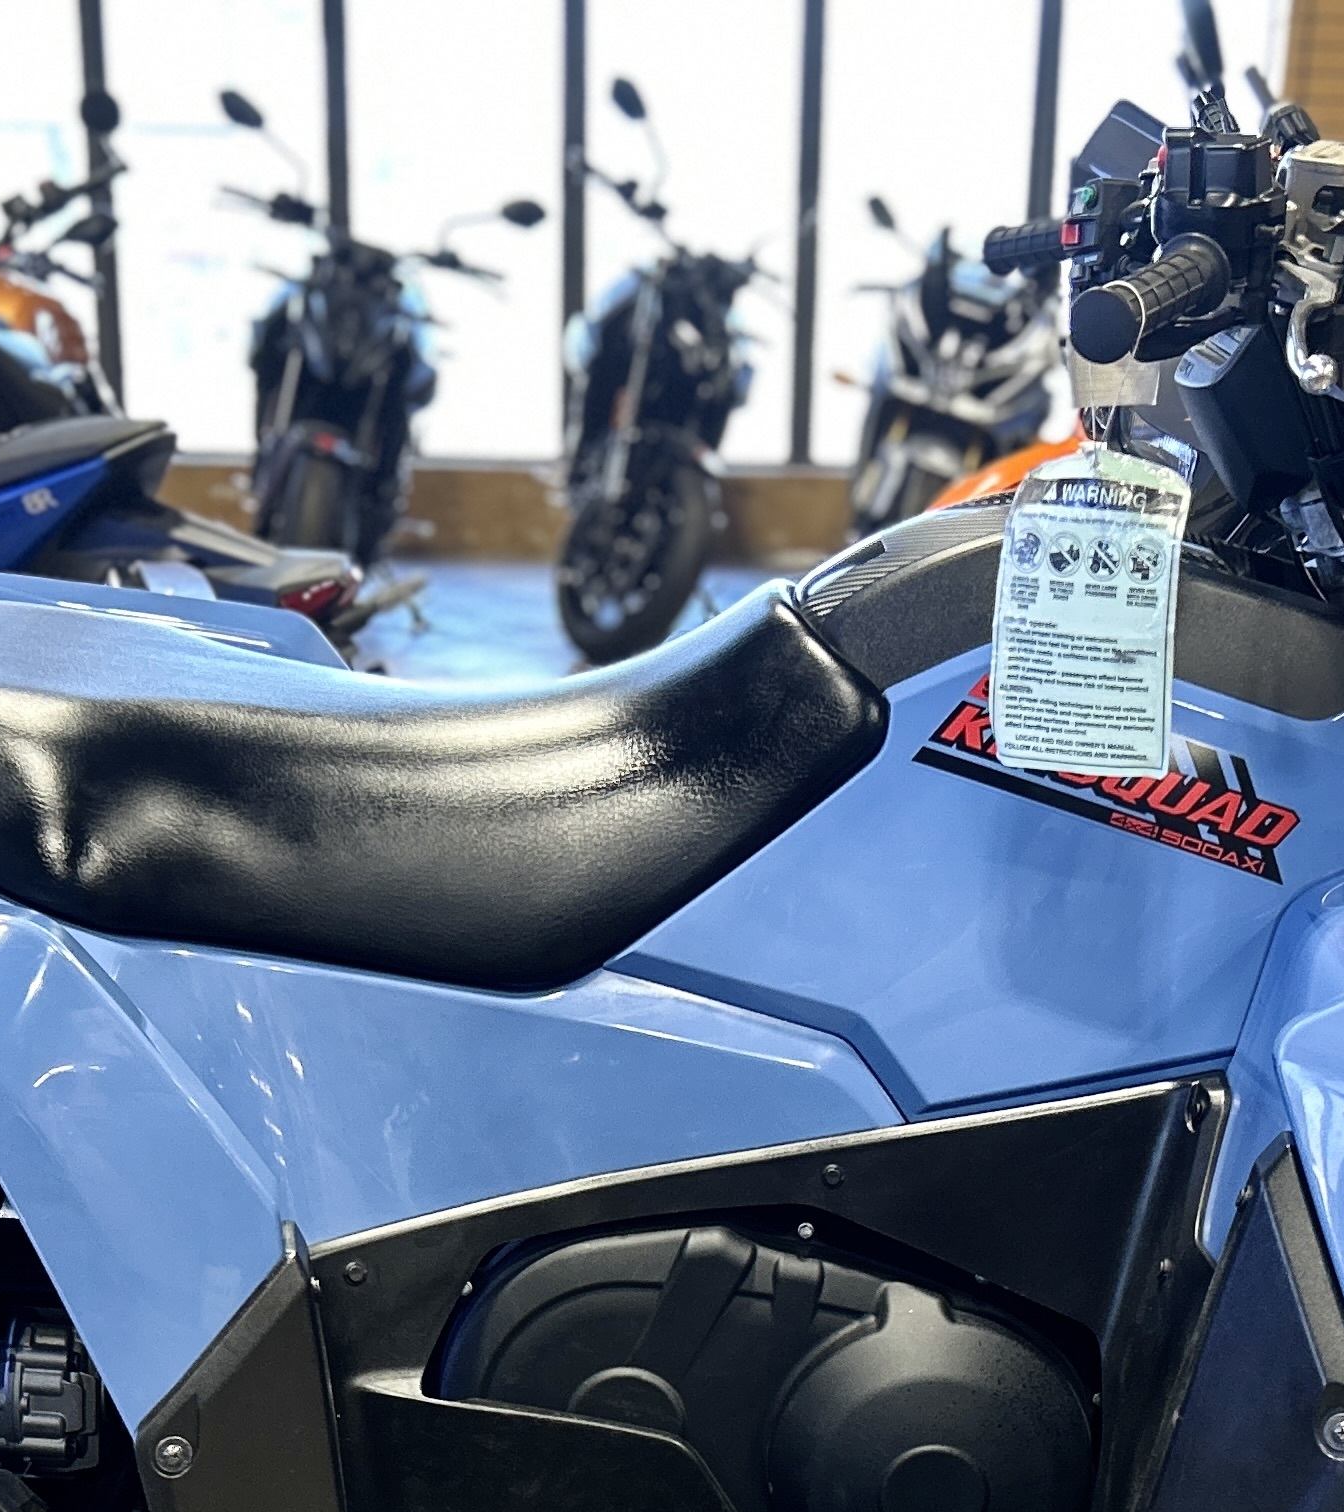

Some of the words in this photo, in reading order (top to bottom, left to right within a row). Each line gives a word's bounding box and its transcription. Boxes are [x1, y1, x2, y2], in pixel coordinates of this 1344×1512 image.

[1062, 483, 1147, 509] WARNING
[931, 702, 1302, 848] KQUAD
[1110, 812, 1158, 839] 4x4
